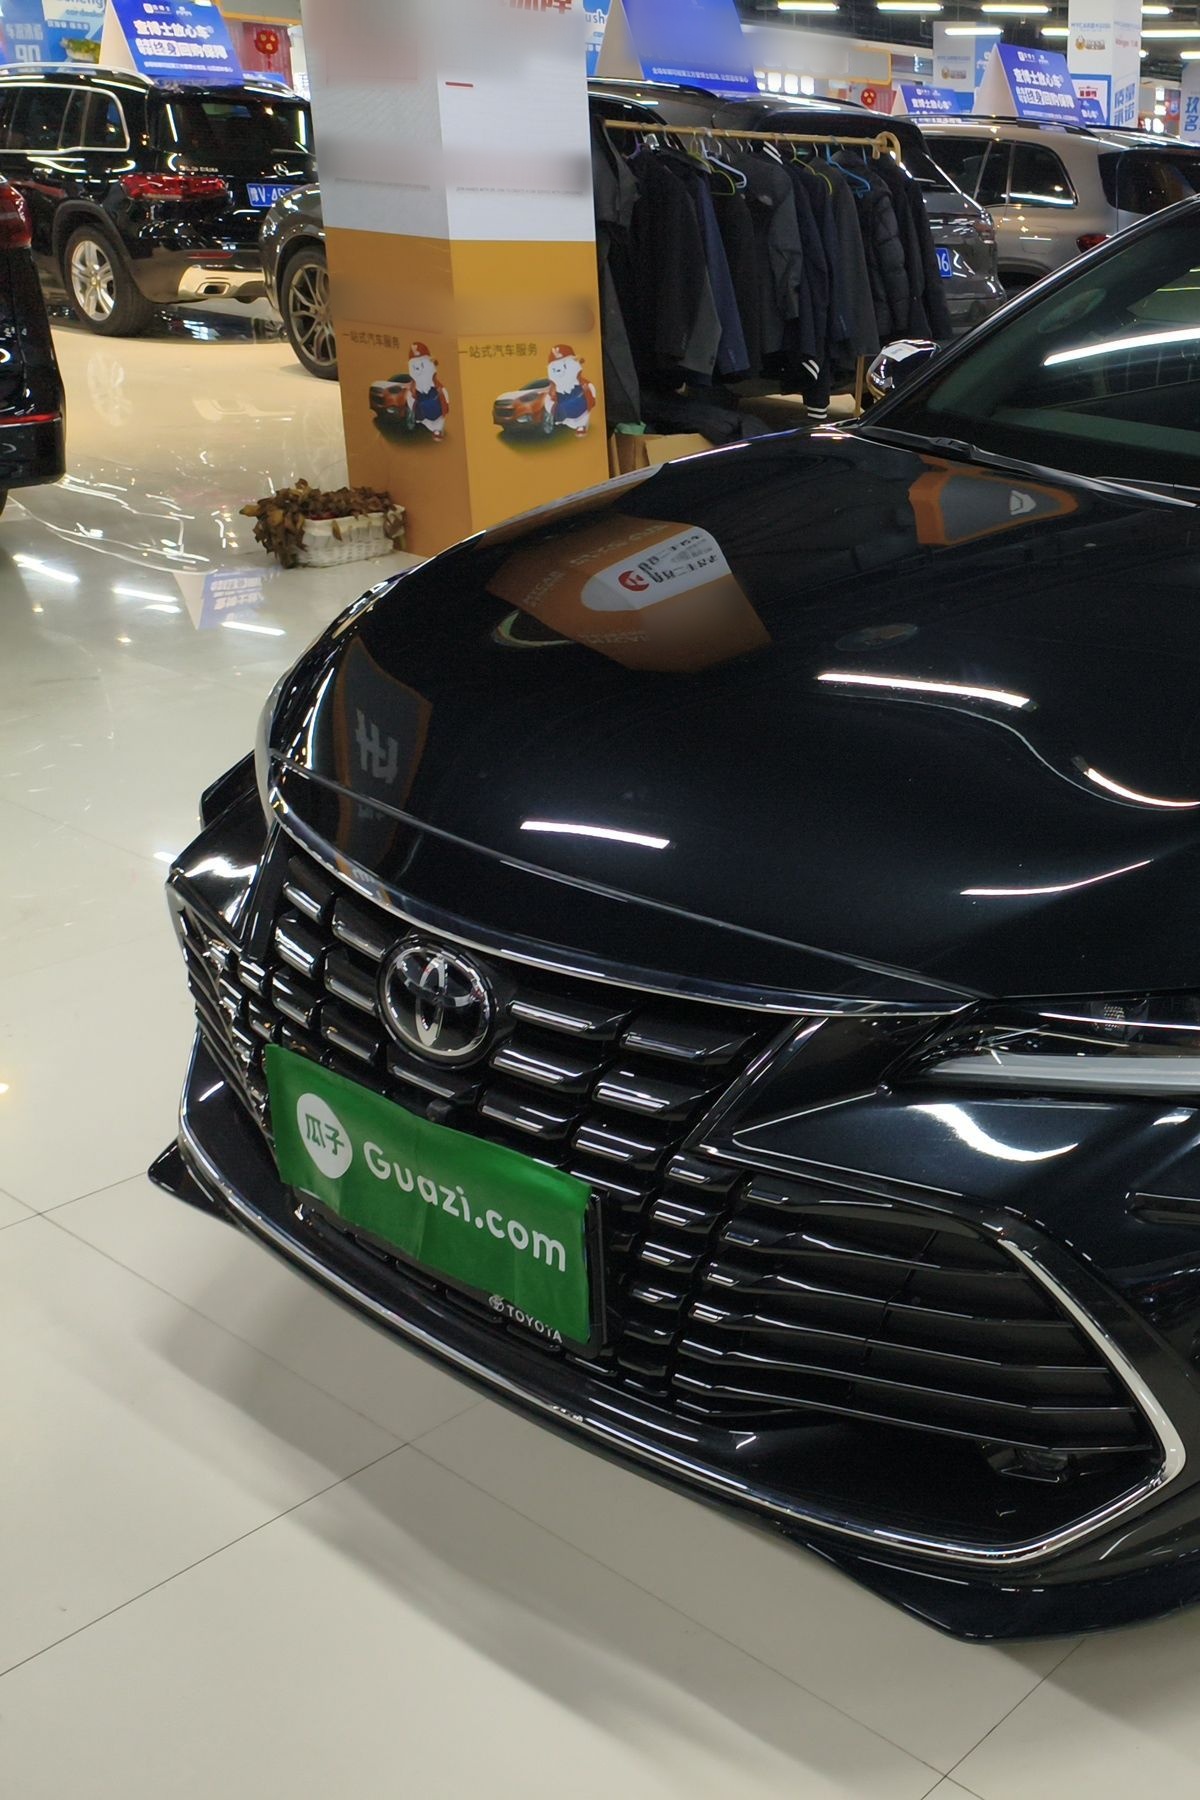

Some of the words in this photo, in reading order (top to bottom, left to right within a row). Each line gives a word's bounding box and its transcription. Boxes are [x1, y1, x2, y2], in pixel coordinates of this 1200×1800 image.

[343, 332, 400, 350] 一站式汽车服务
[458, 343, 537, 359] 一站式汽车服务
[305, 1113, 345, 1156] 瓜子
[363, 1140, 566, 1272] Guazi.com
[506, 1306, 563, 1344] TOYOTA
